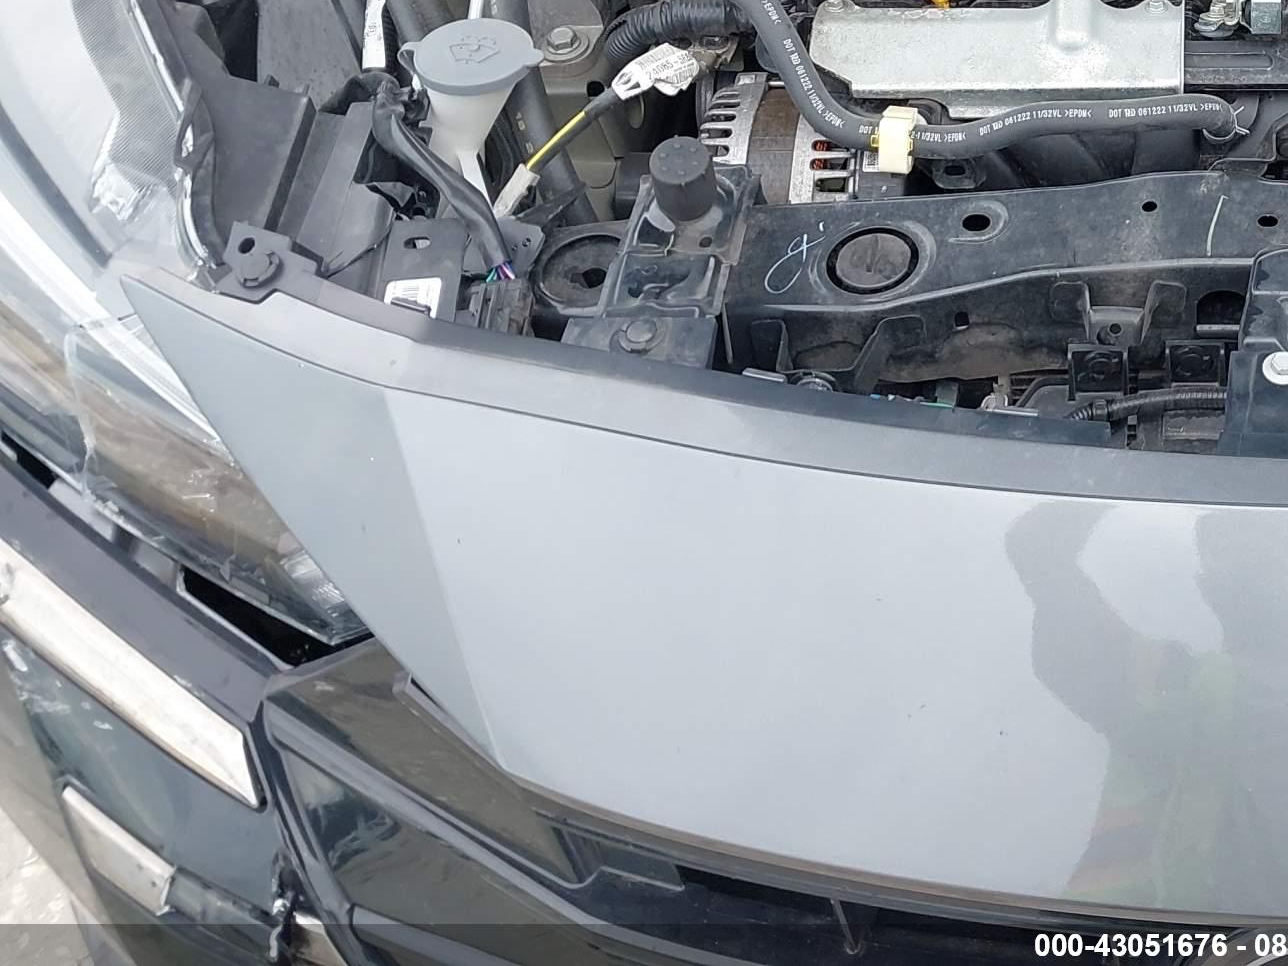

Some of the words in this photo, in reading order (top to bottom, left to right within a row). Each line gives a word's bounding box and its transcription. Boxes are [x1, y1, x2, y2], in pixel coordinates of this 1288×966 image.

[1004, 112, 1031, 126] 061222
[1064, 109, 1092, 118] >EPDM<
[1138, 106, 1166, 116] 061222
